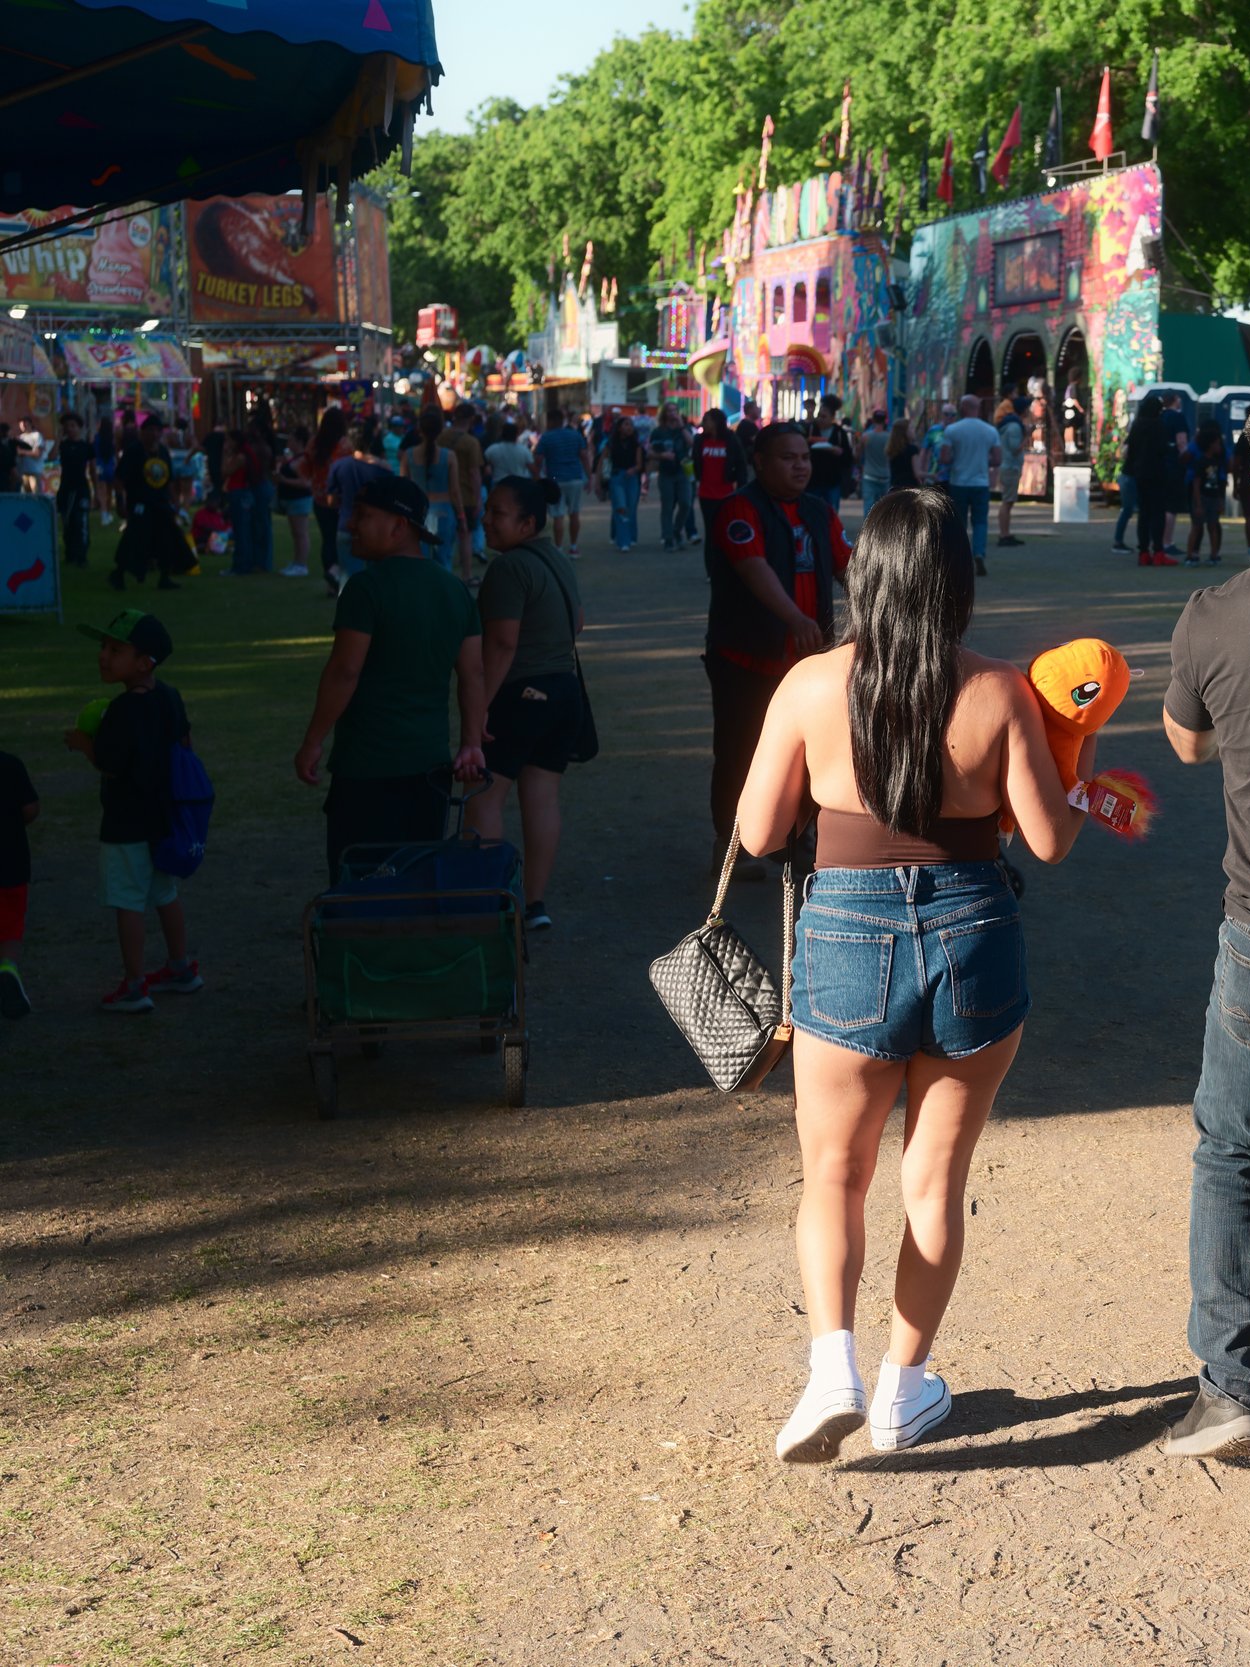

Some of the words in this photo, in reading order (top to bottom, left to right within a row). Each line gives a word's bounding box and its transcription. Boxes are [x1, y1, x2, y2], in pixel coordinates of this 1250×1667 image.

[3, 239, 88, 281] Whip
[87, 281, 144, 302] Strawberry
[197, 271, 258, 306] TURKEY
[262, 283, 304, 308] LEGS
[702, 446, 727, 457] PINK
